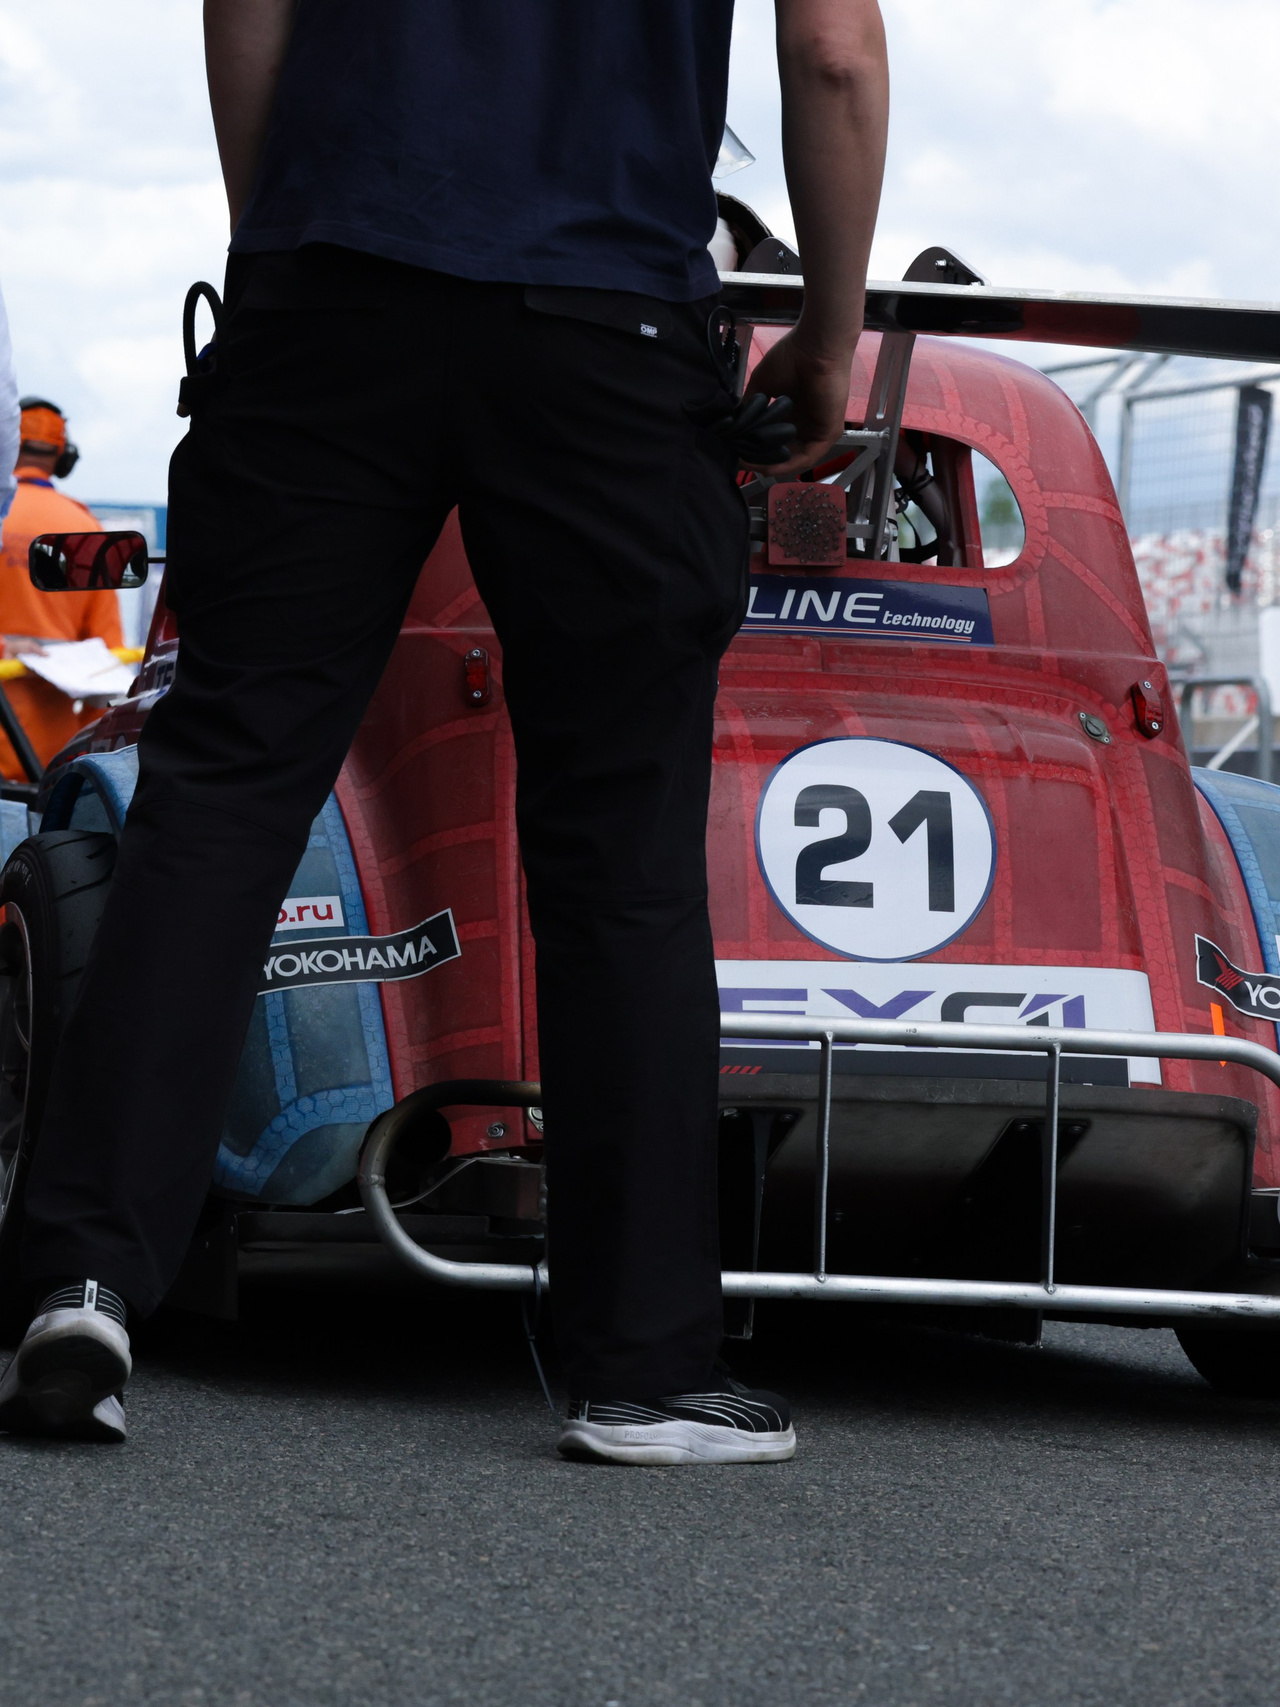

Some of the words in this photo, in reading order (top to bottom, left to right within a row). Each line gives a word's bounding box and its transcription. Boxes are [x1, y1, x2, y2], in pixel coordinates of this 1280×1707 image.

[882, 610, 975, 634] technology
[793, 783, 955, 913] 21
[263, 935, 438, 981] YOKOHAMA
